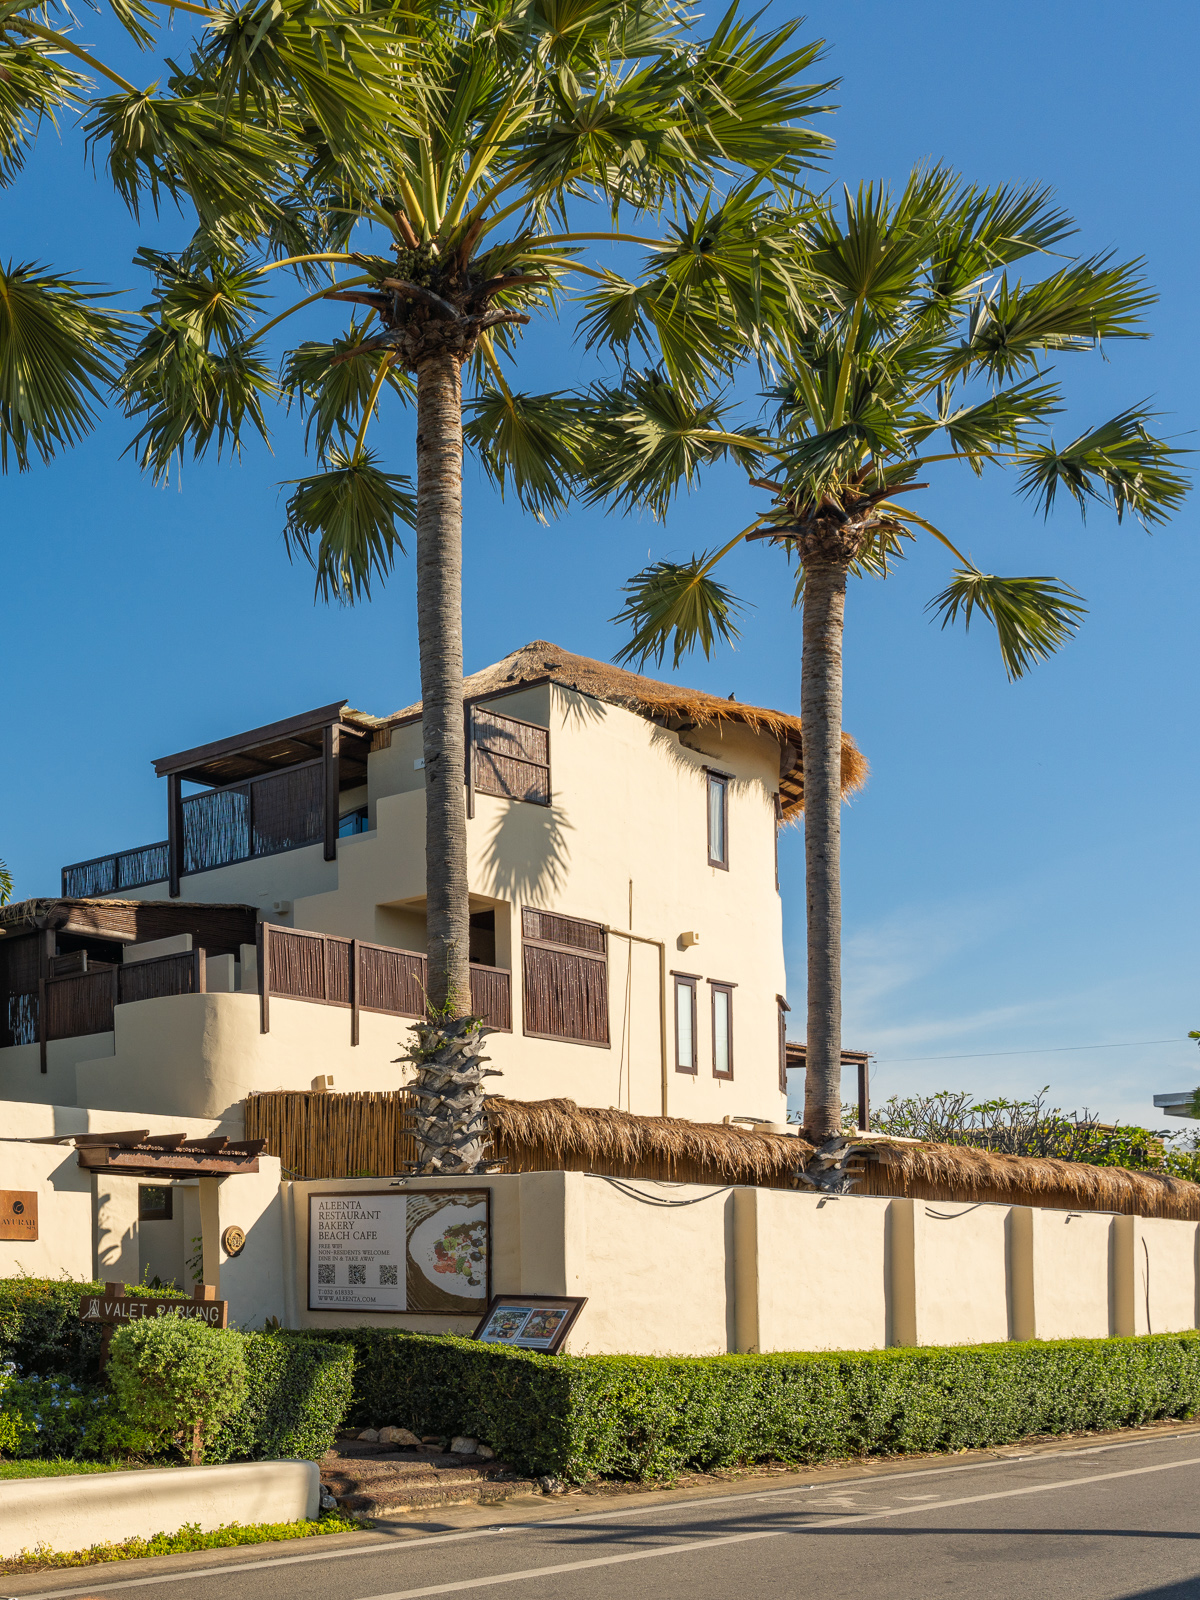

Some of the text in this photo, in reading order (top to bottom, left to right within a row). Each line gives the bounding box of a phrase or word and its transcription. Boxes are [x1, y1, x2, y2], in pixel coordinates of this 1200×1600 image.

[318, 1201, 362, 1210] ALEENTA
[318, 1211, 381, 1220] RESTAURANT
[318, 1221, 355, 1230] BAKERY
[318, 1231, 378, 1240] BEACH CAFE
[104, 1303, 148, 1318] VALET
